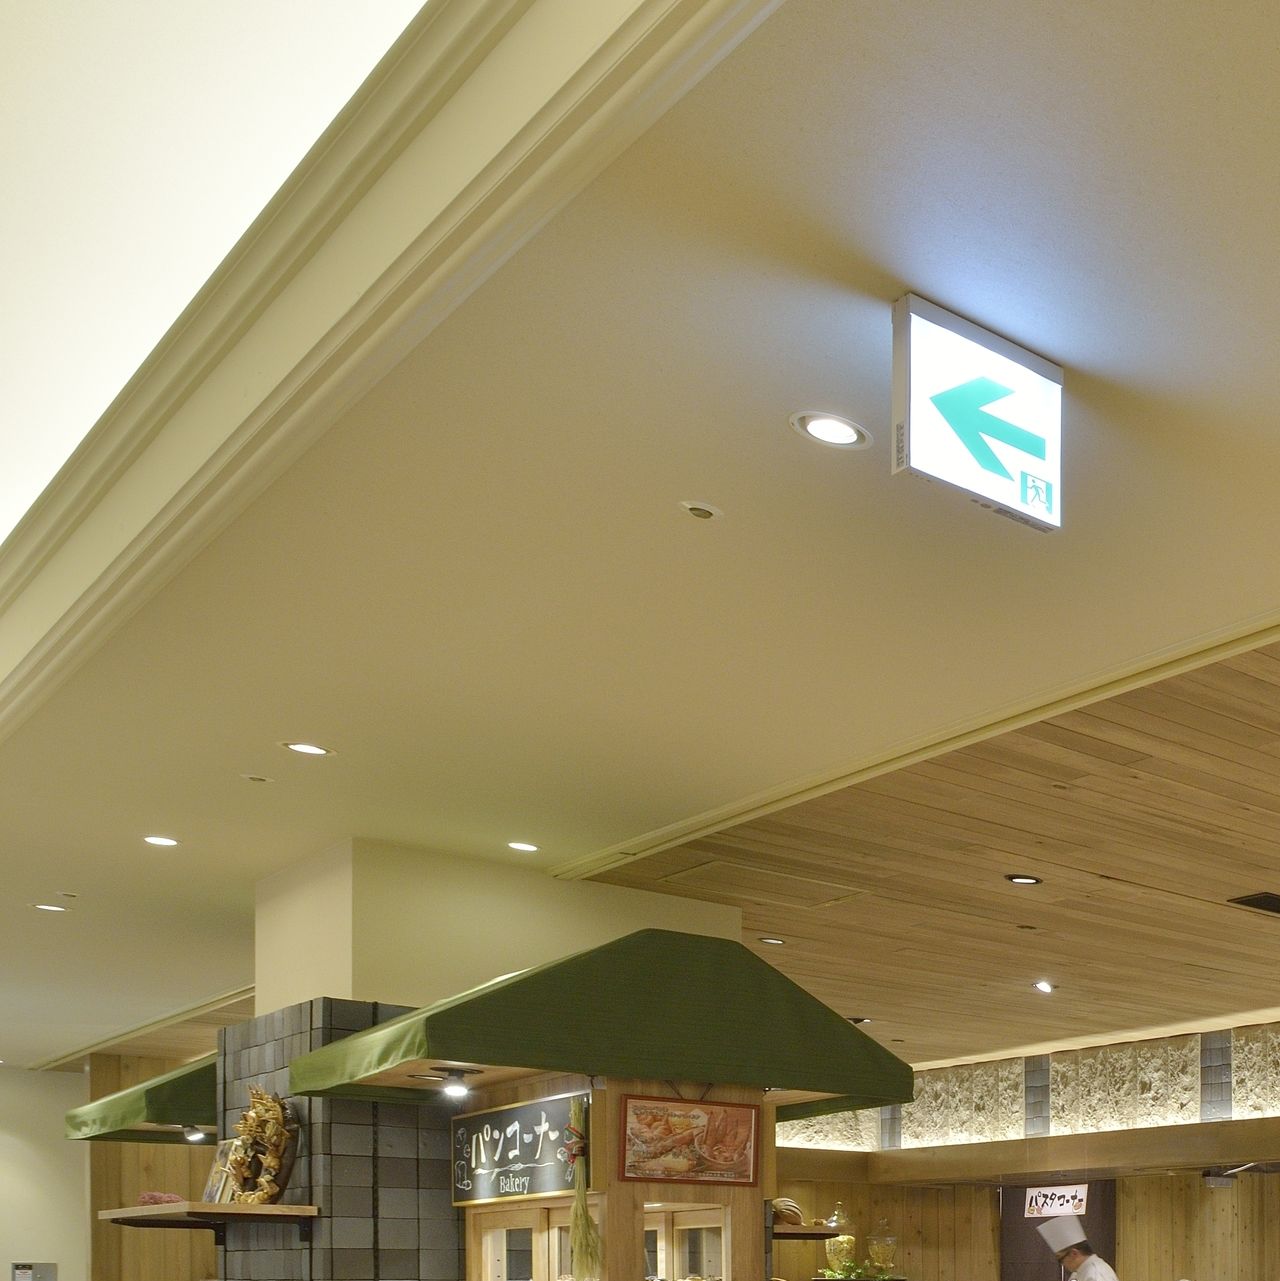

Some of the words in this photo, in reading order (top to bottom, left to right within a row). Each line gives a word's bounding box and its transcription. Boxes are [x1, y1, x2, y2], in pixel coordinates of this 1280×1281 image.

[471, 1111, 560, 1168] パンコーナー
[500, 1174, 530, 1194] Bakery
[1029, 1189, 1084, 1208] パスタコーナー
